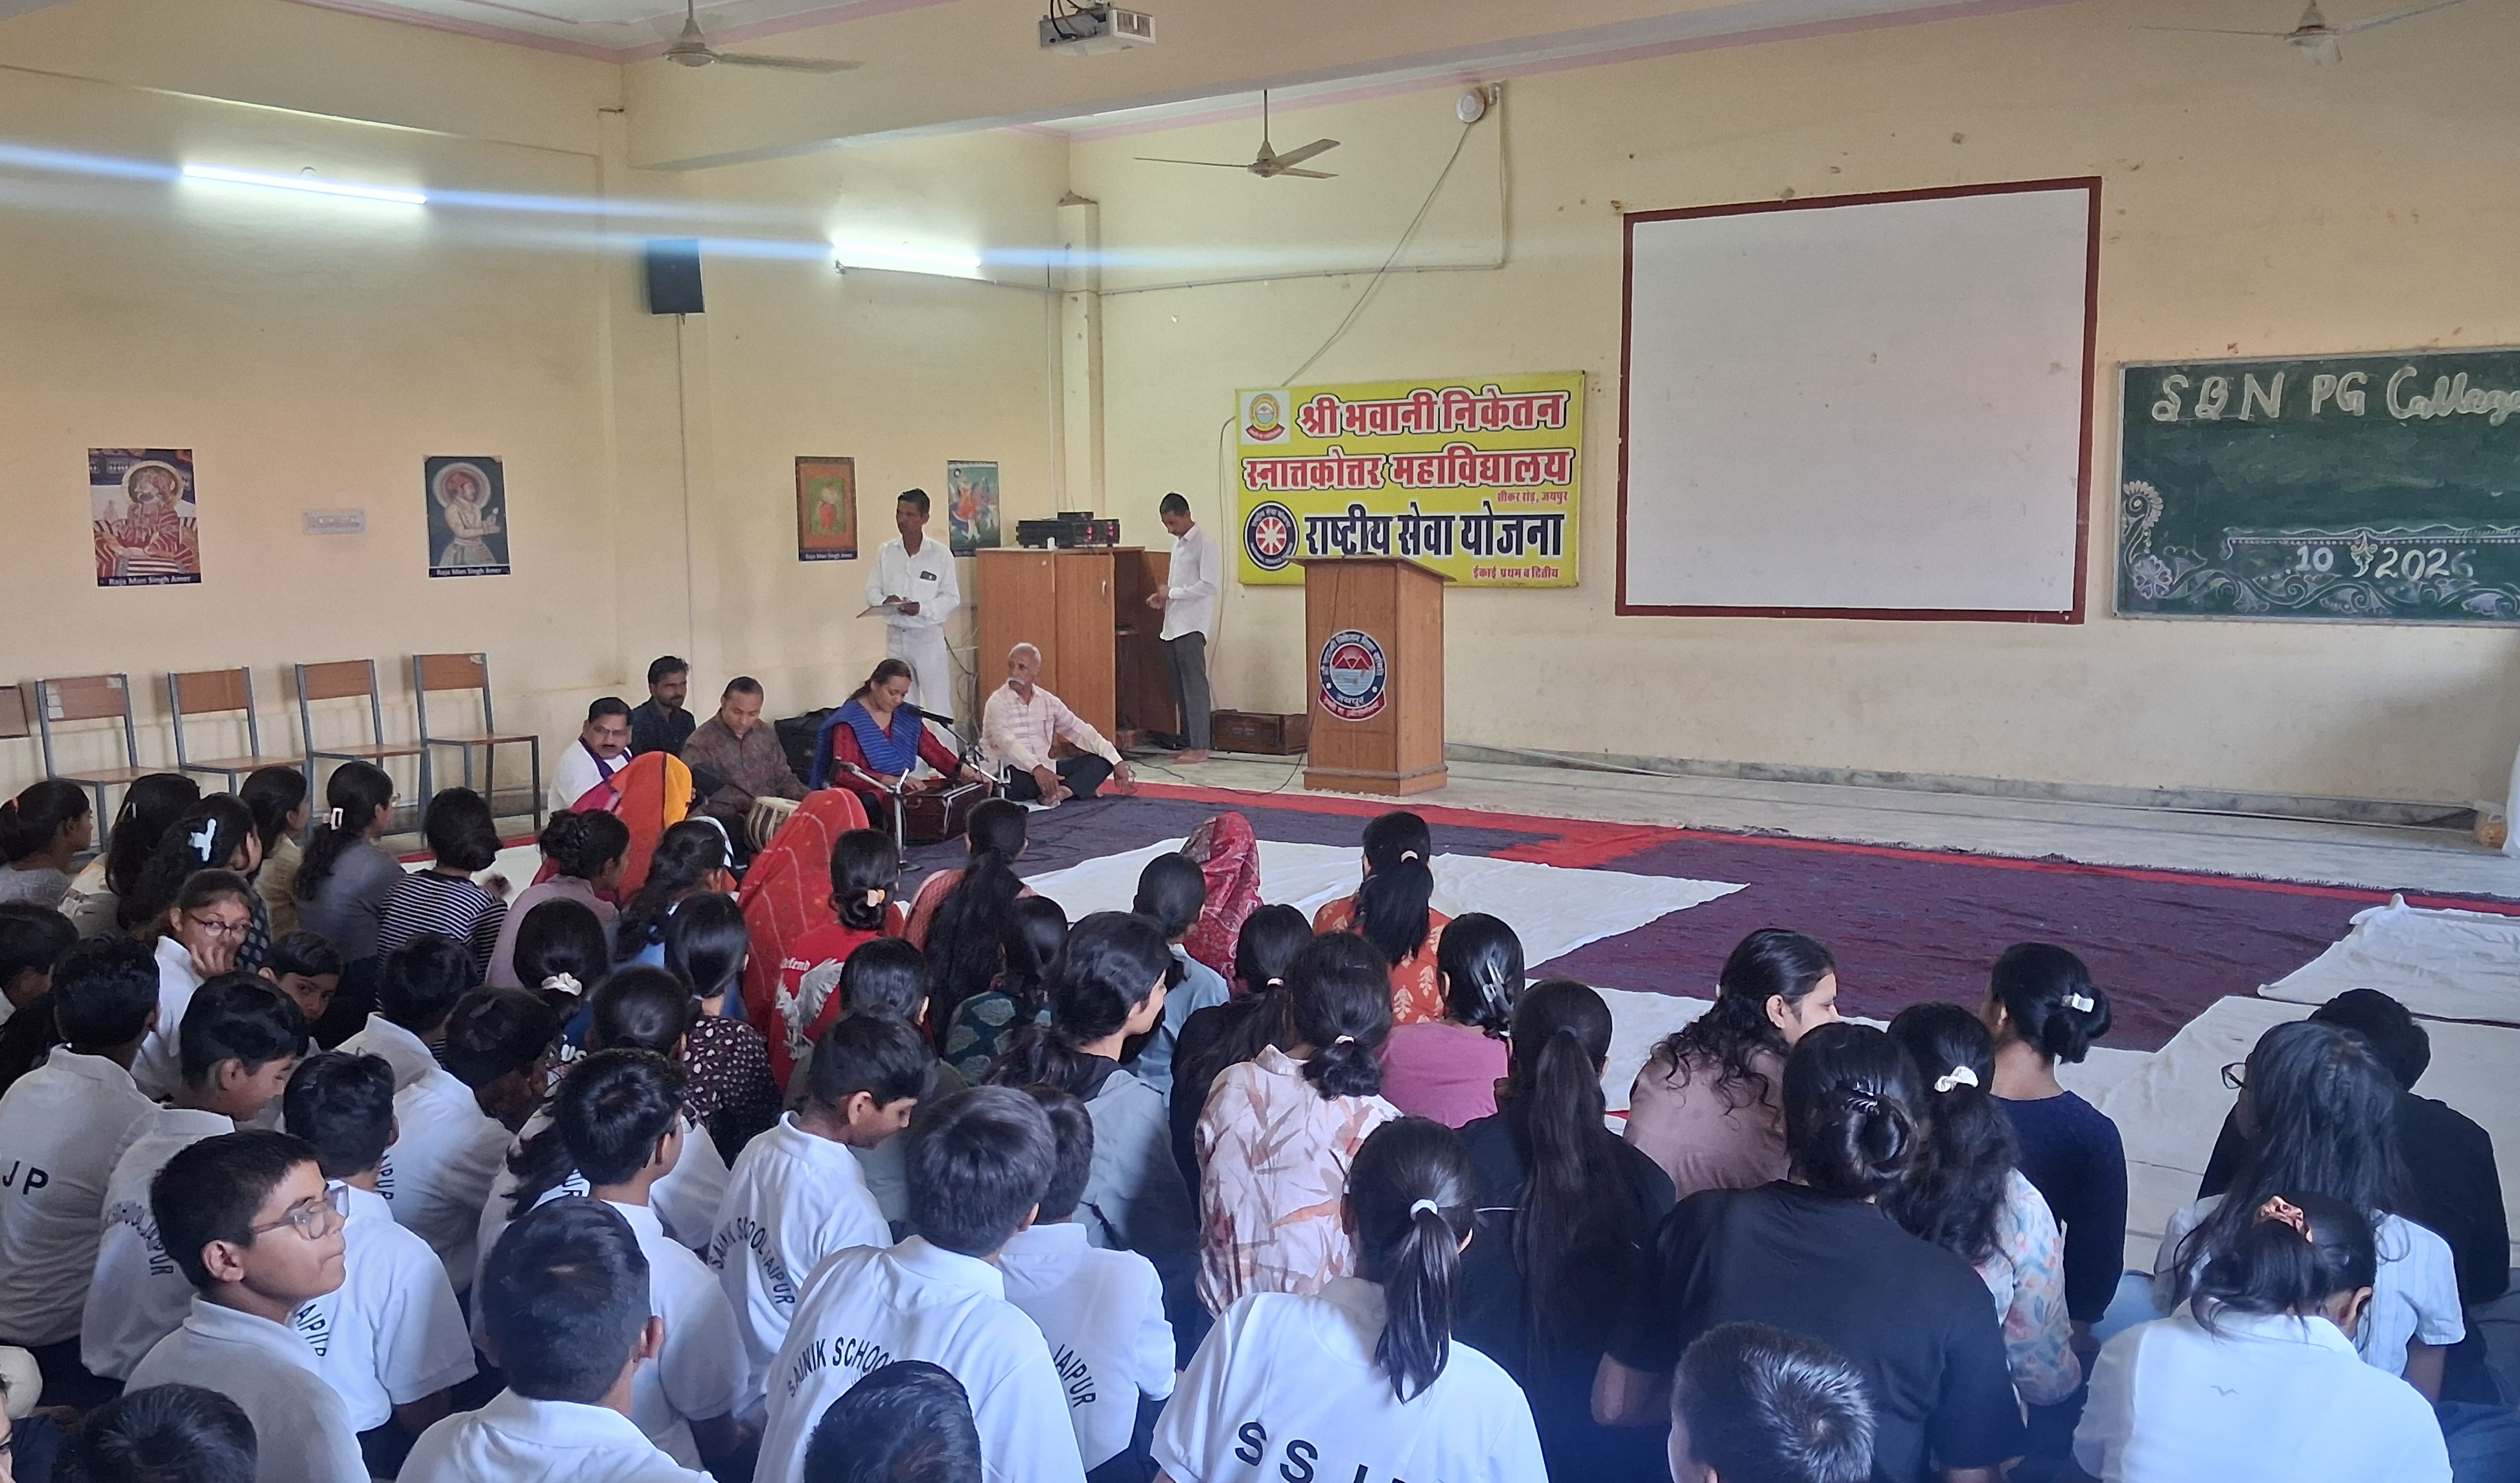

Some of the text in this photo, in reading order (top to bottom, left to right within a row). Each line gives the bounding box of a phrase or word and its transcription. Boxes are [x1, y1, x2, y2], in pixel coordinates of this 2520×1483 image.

[1300, 396, 1340, 435] श्री
[1345, 391, 1438, 434] भवानी
[1442, 388, 1565, 430] निकेतन
[2311, 371, 2368, 416] PG
[1393, 445, 1570, 485] महाविद्यालय
[1541, 491, 1568, 505] जयपुर
[1398, 502, 1456, 555] सेवा
[1460, 500, 1565, 555] योजना
[787, 1336, 895, 1398] SAINIK SCHOO
